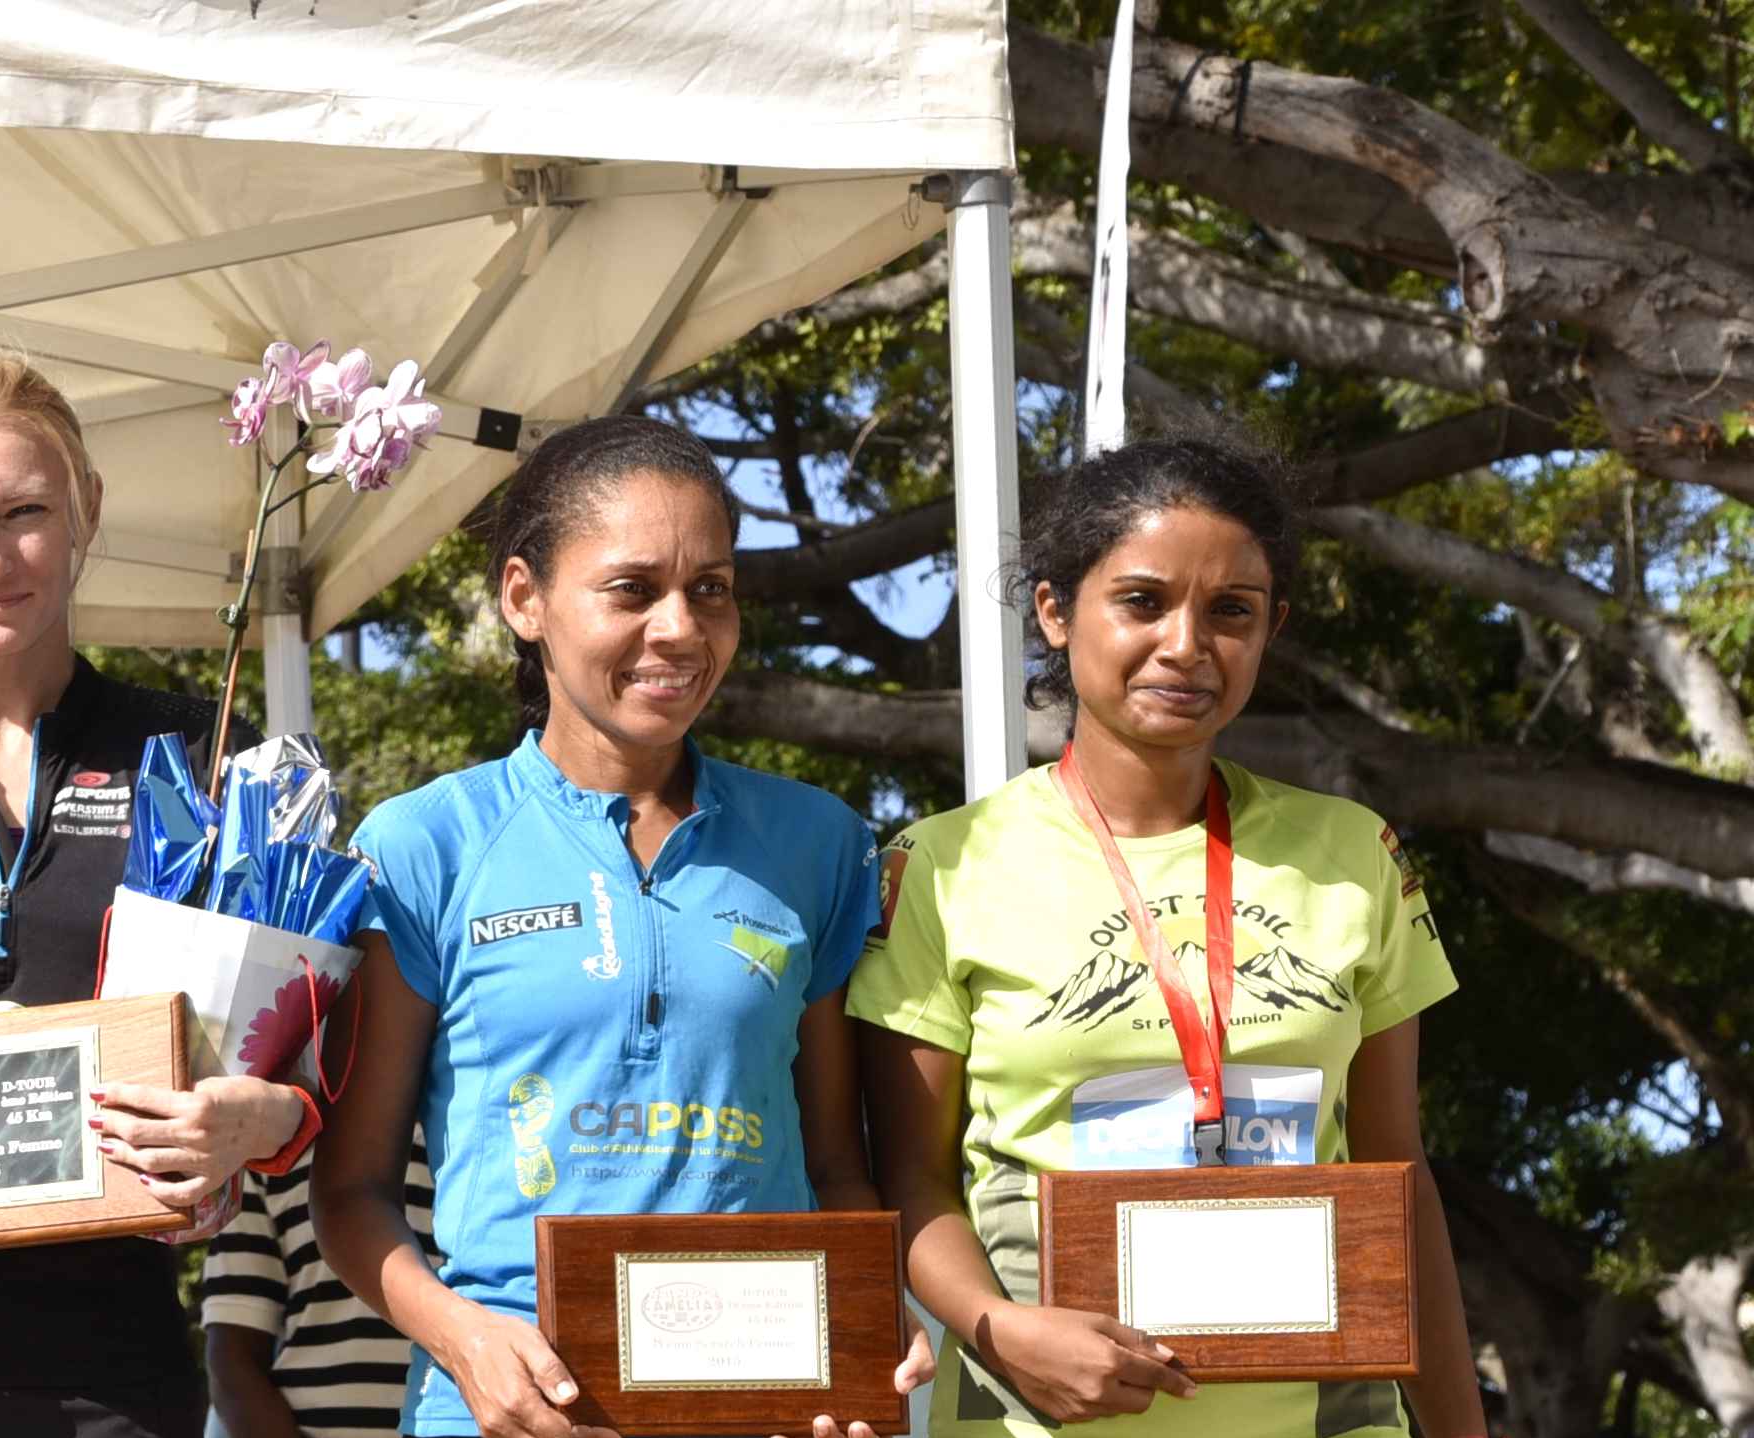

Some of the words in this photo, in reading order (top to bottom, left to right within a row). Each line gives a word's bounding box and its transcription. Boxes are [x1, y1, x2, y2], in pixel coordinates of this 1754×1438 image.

[472, 905, 579, 944] NESCAFÉ
[1090, 895, 1183, 947] OUST
[1, 1076, 56, 1093] D-TOUR
[6, 1111, 24, 1125] 45
[26, 1109, 53, 1123] Km
[570, 1101, 763, 1148] CAPOSS
[8, 1138, 63, 1154] Femme
[569, 1143, 598, 1153] Club
